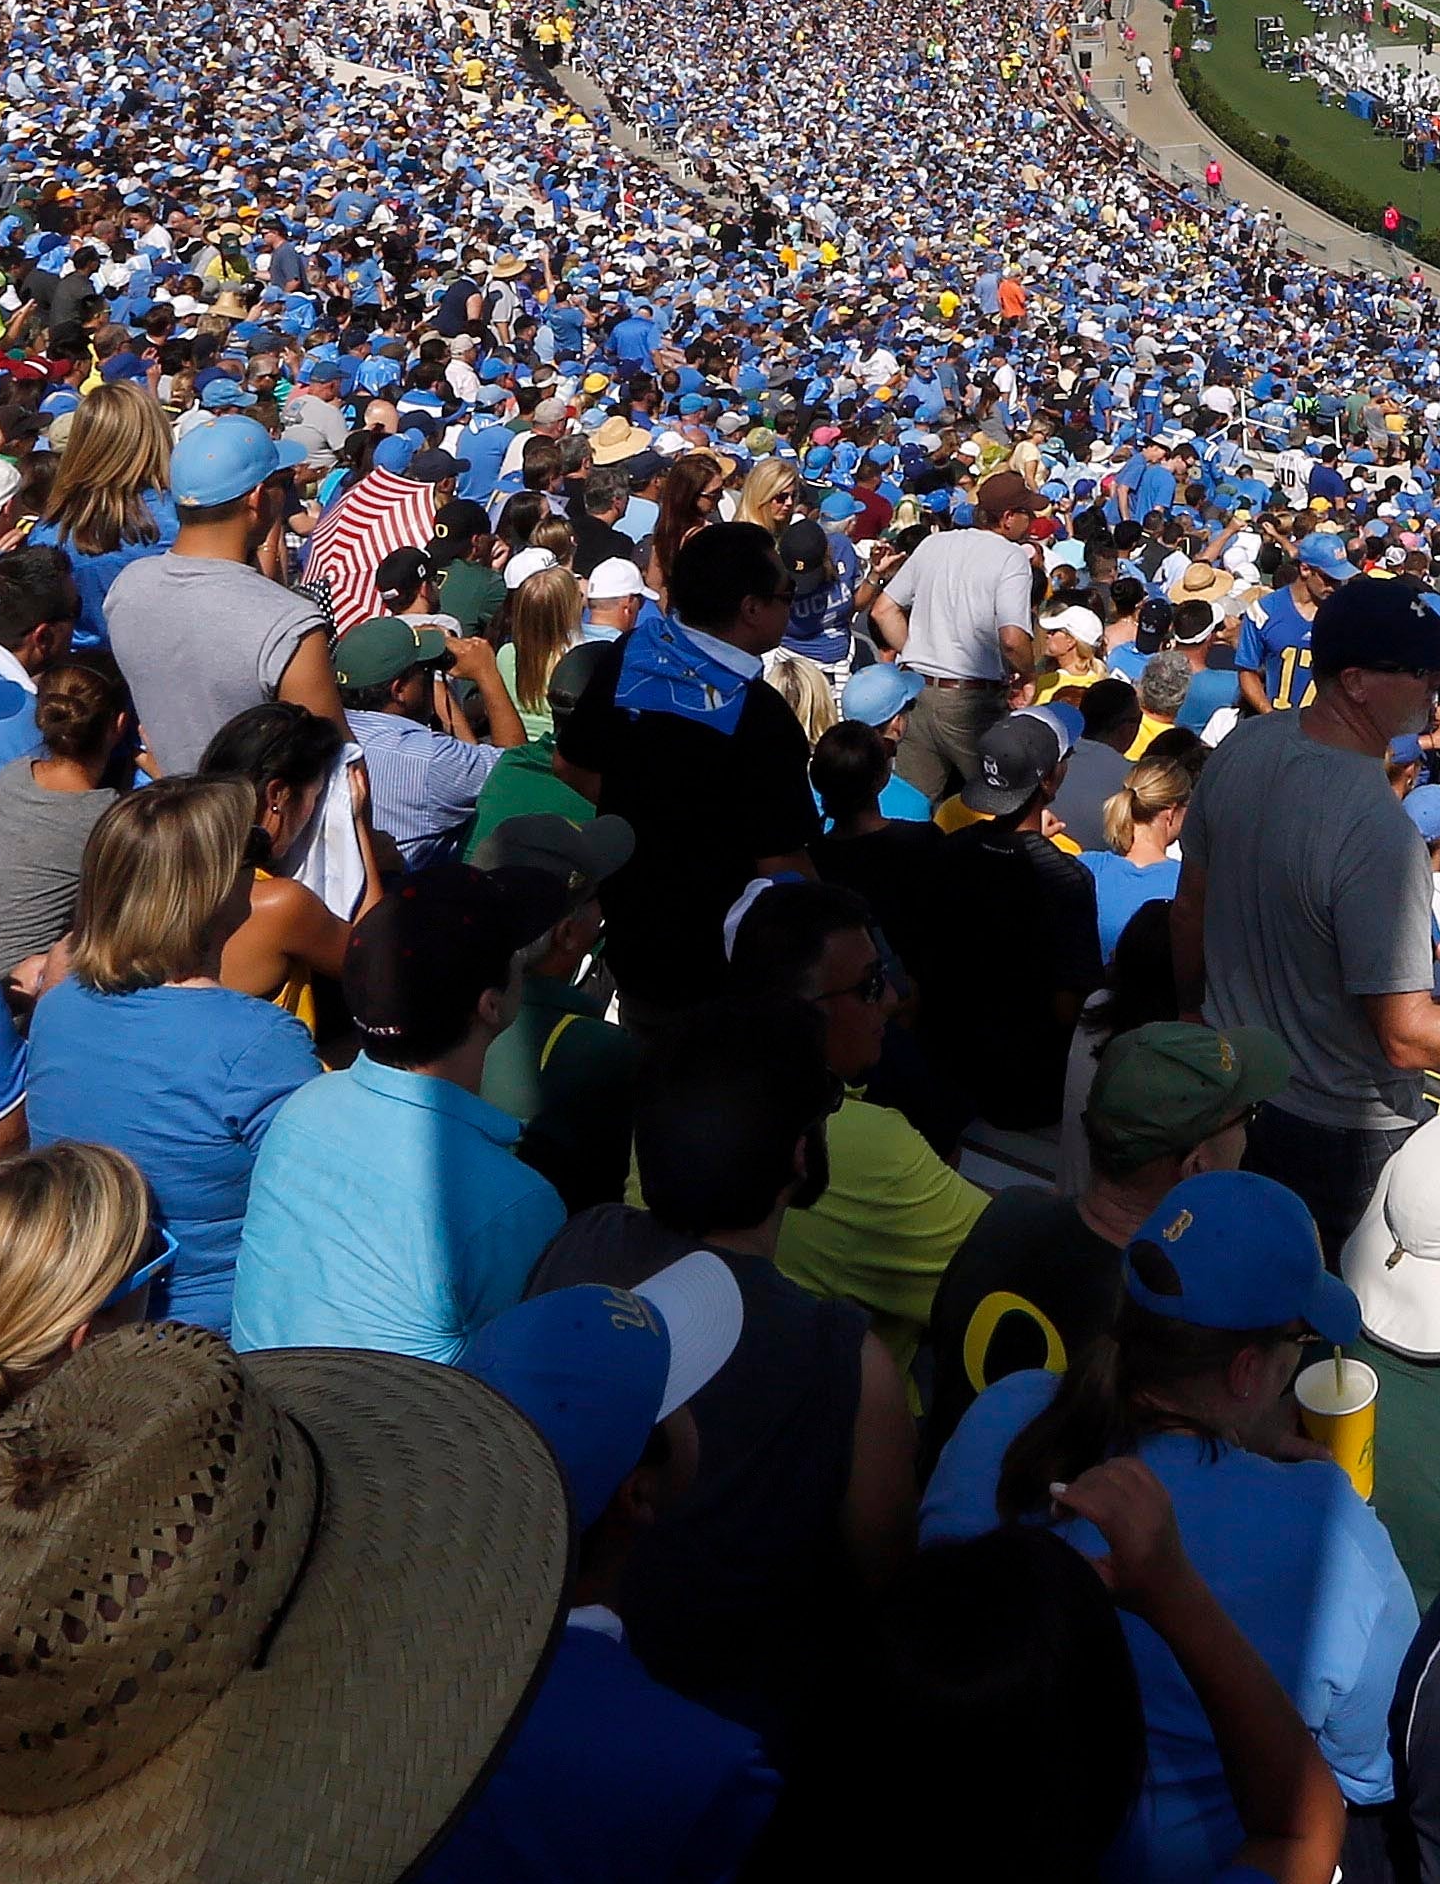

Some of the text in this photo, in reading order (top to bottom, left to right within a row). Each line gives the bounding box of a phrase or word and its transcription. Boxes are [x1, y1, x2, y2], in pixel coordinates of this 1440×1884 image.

[1280, 467, 1295, 488] 10
[434, 522, 449, 539] O
[793, 582, 852, 618] UCLA
[962, 1289, 1069, 1397] O
